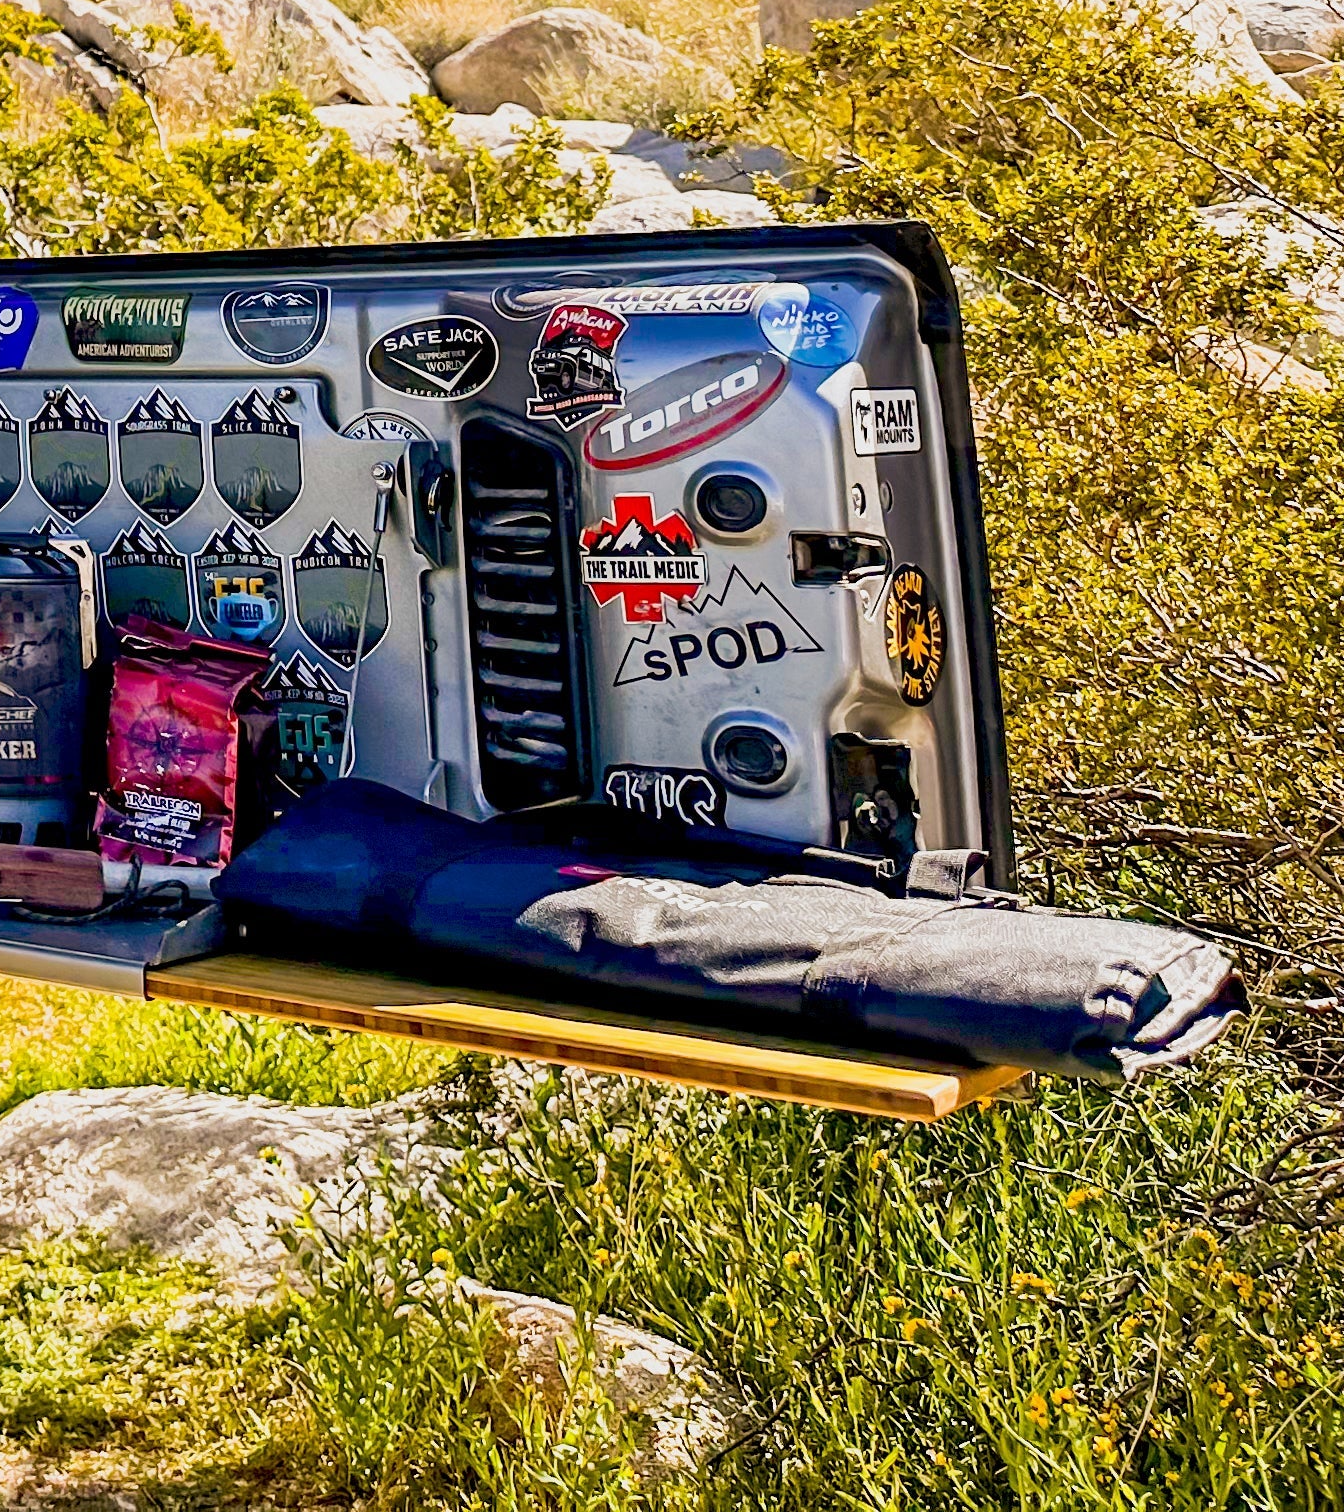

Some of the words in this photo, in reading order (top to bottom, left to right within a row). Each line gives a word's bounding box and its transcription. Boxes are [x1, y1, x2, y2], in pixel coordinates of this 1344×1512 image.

[383, 329, 443, 353] SAFE
[445, 328, 485, 345] JACK
[77, 343, 118, 357] AMERICAN
[119, 343, 173, 358] ADVENTURIST
[599, 363, 760, 454] Torco
[874, 399, 914, 428] RAM
[31, 420, 63, 433] JOHN
[74, 420, 106, 434] BULL
[221, 423, 253, 435] SLICK
[261, 423, 290, 437] ROCK
[876, 429, 915, 445] MOUNTS
[295, 556, 340, 570] RUBICON
[585, 560, 608, 580] THE
[610, 560, 651, 580] TRAIL
[654, 560, 700, 580] MEDIC
[644, 620, 787, 683] sPOD
